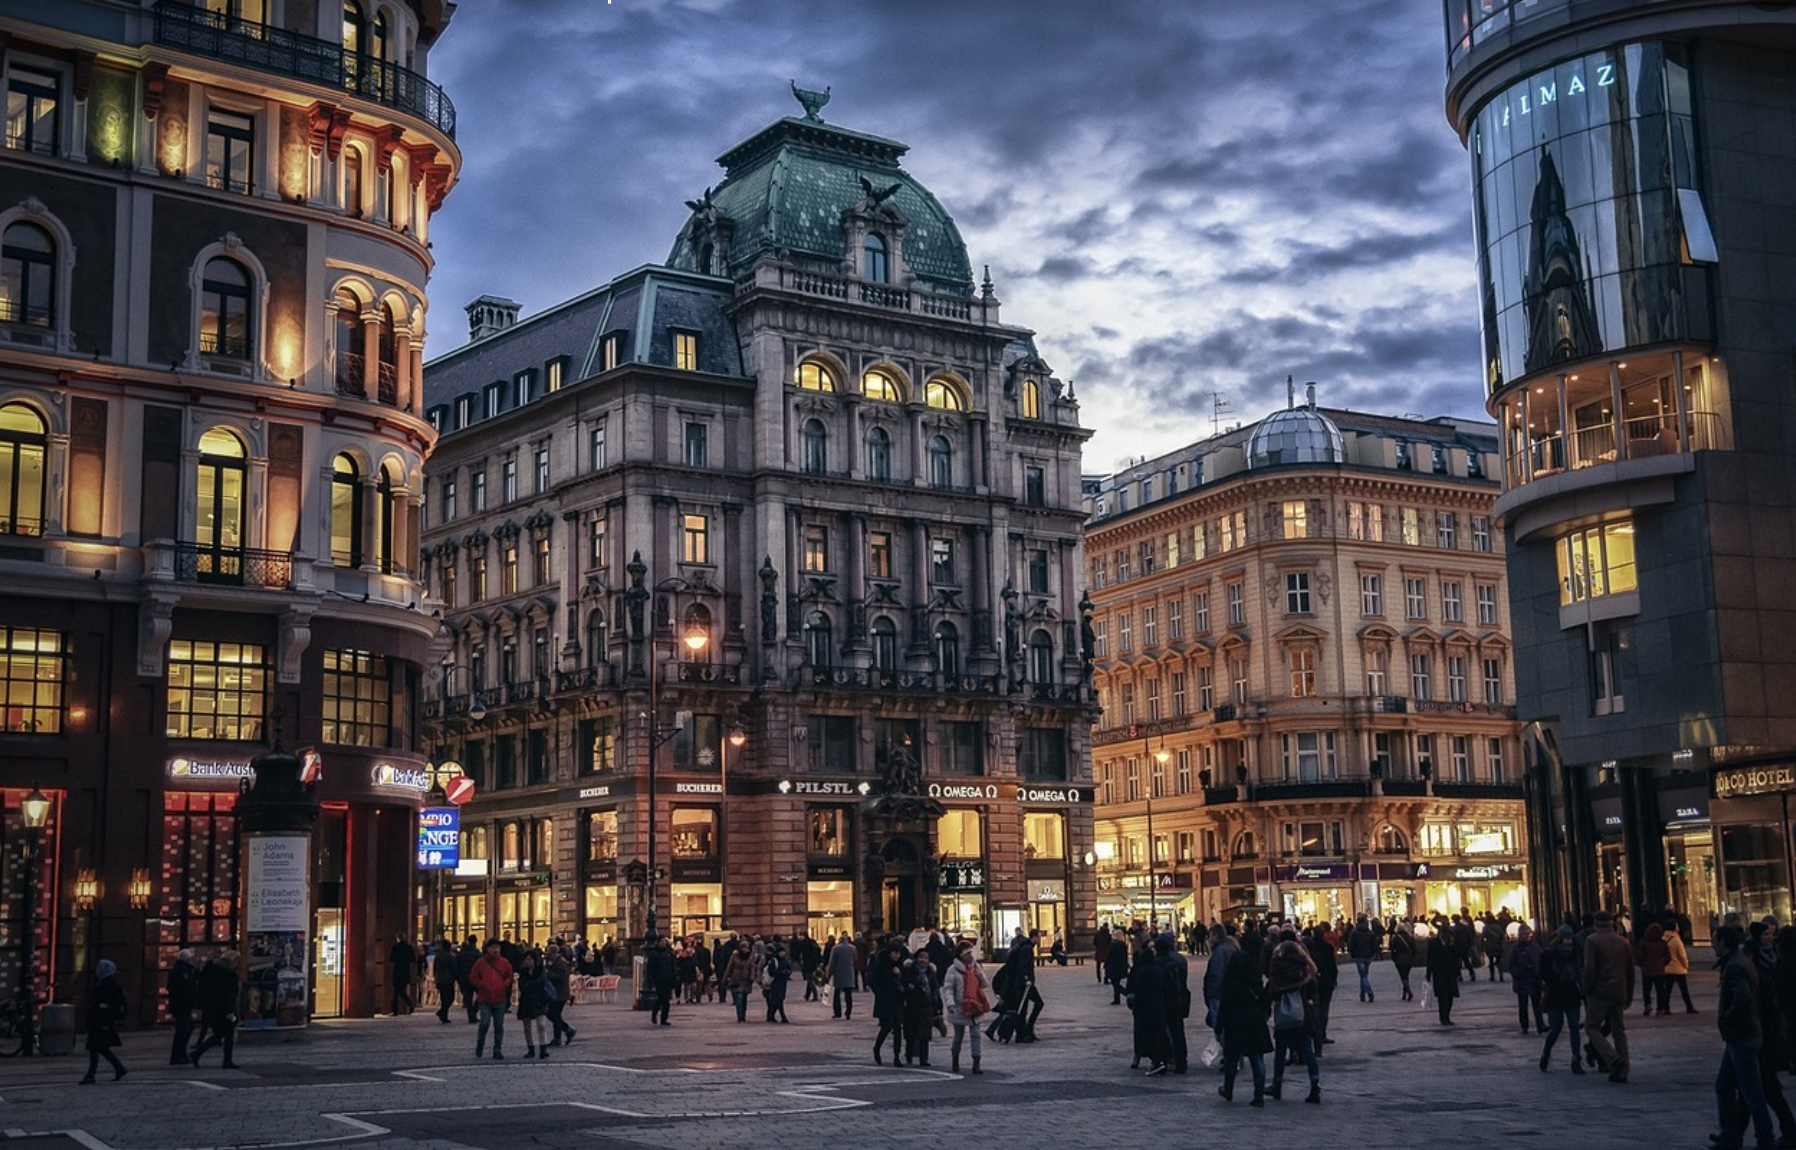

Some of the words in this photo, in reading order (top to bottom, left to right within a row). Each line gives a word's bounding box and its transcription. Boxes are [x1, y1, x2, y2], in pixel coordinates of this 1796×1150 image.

[190, 760, 224, 775] Bank
[1747, 768, 1794, 787] HOTEL
[676, 783, 723, 793] BUCHERER
[795, 782, 853, 794] PILSTL
[943, 786, 983, 798] OMEGA
[1028, 790, 1067, 802] OMEGA
[263, 842, 286, 852] John
[262, 852, 295, 860] Adams
